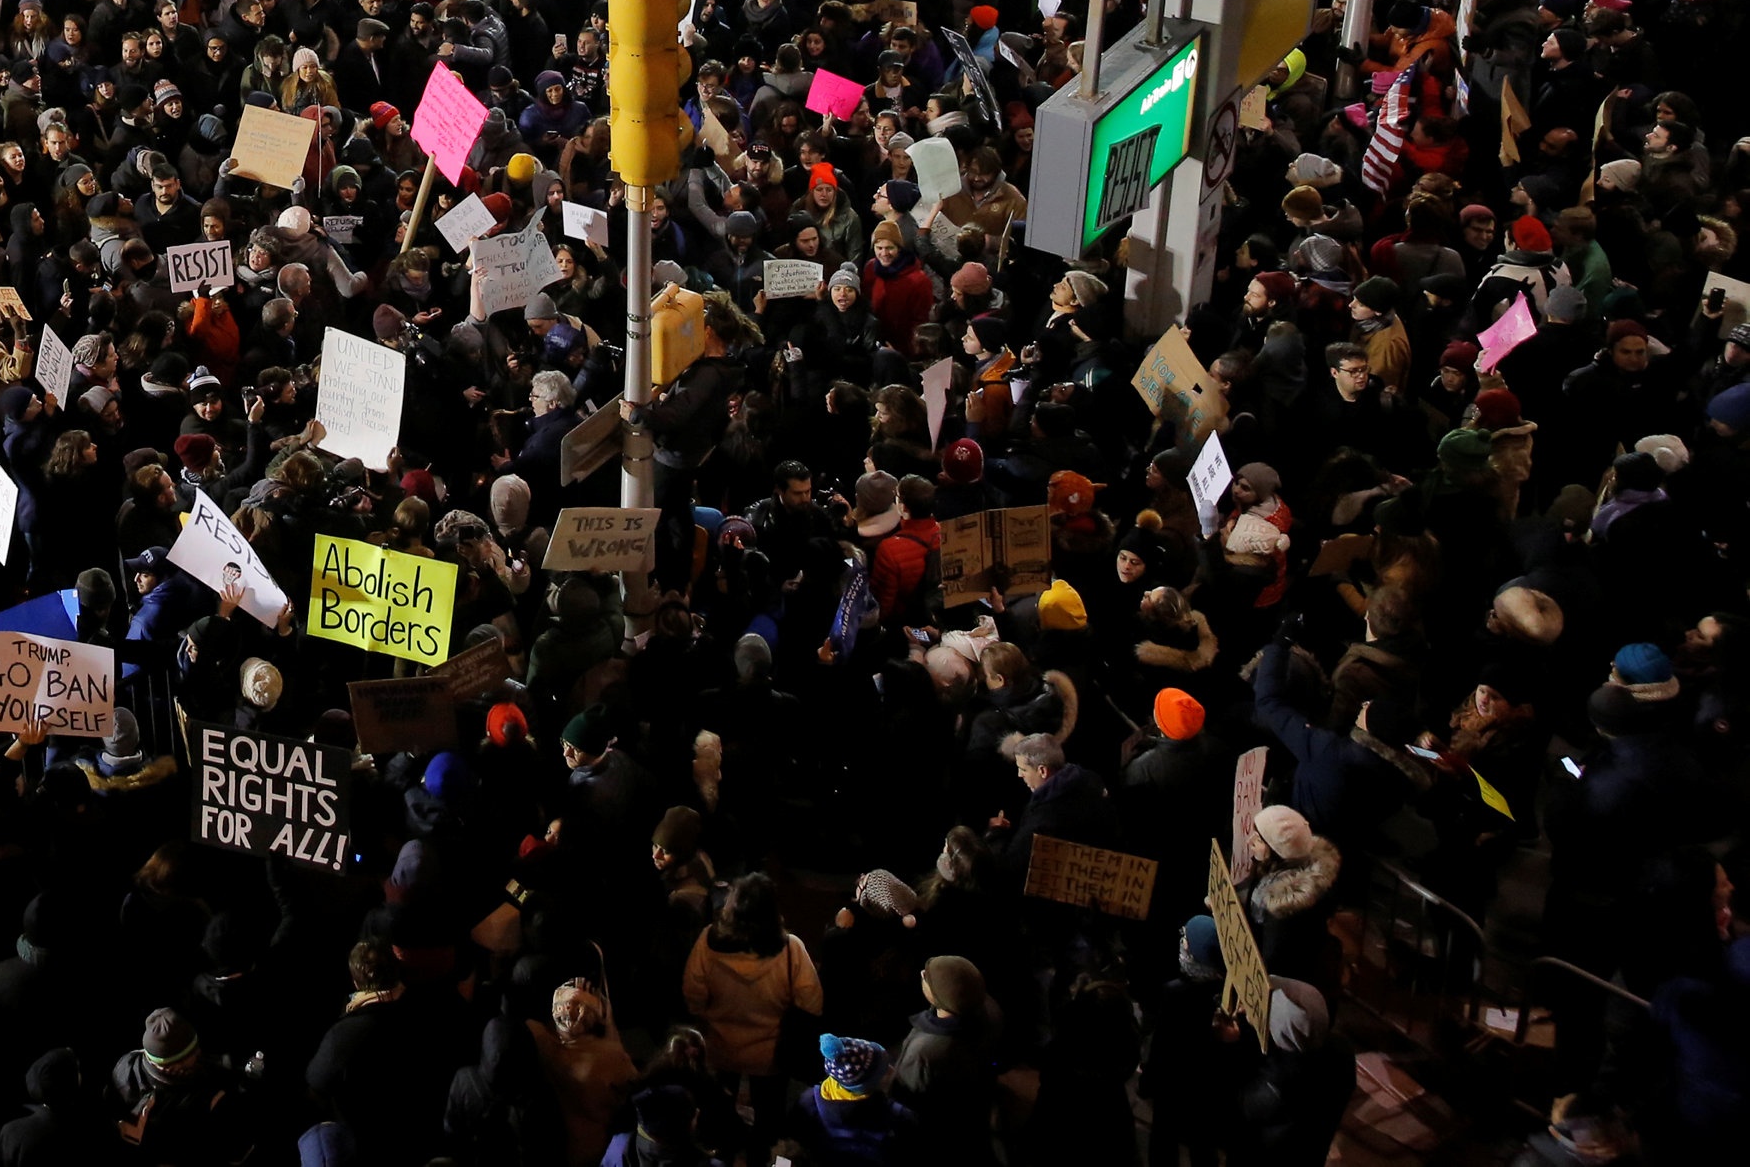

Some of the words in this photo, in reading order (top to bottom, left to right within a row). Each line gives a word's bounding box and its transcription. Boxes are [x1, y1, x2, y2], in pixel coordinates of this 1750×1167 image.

[1098, 126, 1162, 227] RESIST
[172, 245, 230, 283] RESIST
[337, 336, 394, 371] UNITED
[333, 359, 357, 377] WE
[365, 368, 402, 394] STAND
[1207, 463, 1217, 482] ARE
[1214, 452, 1223, 470] WE
[572, 517, 616, 533] THIS
[623, 517, 644, 532] IS
[321, 542, 434, 613] Abolish
[320, 587, 441, 656] Borders
[12, 639, 71, 667] TRUMP,
[47, 670, 108, 704] BAN
[202, 728, 337, 787] EQUAL
[202, 764, 338, 827] RIGHTS
[1235, 780, 1259, 815] BAN
[201, 804, 252, 849] FOR
[269, 823, 348, 871] ALL!
[1067, 861, 1117, 885] THEM
[1125, 876, 1146, 891] IN
[1070, 844, 1122, 868] THEM
[1130, 859, 1150, 875] IN
[1065, 876, 1114, 899] THEM
[1121, 890, 1142, 905] IN
[1120, 904, 1141, 919] IN
